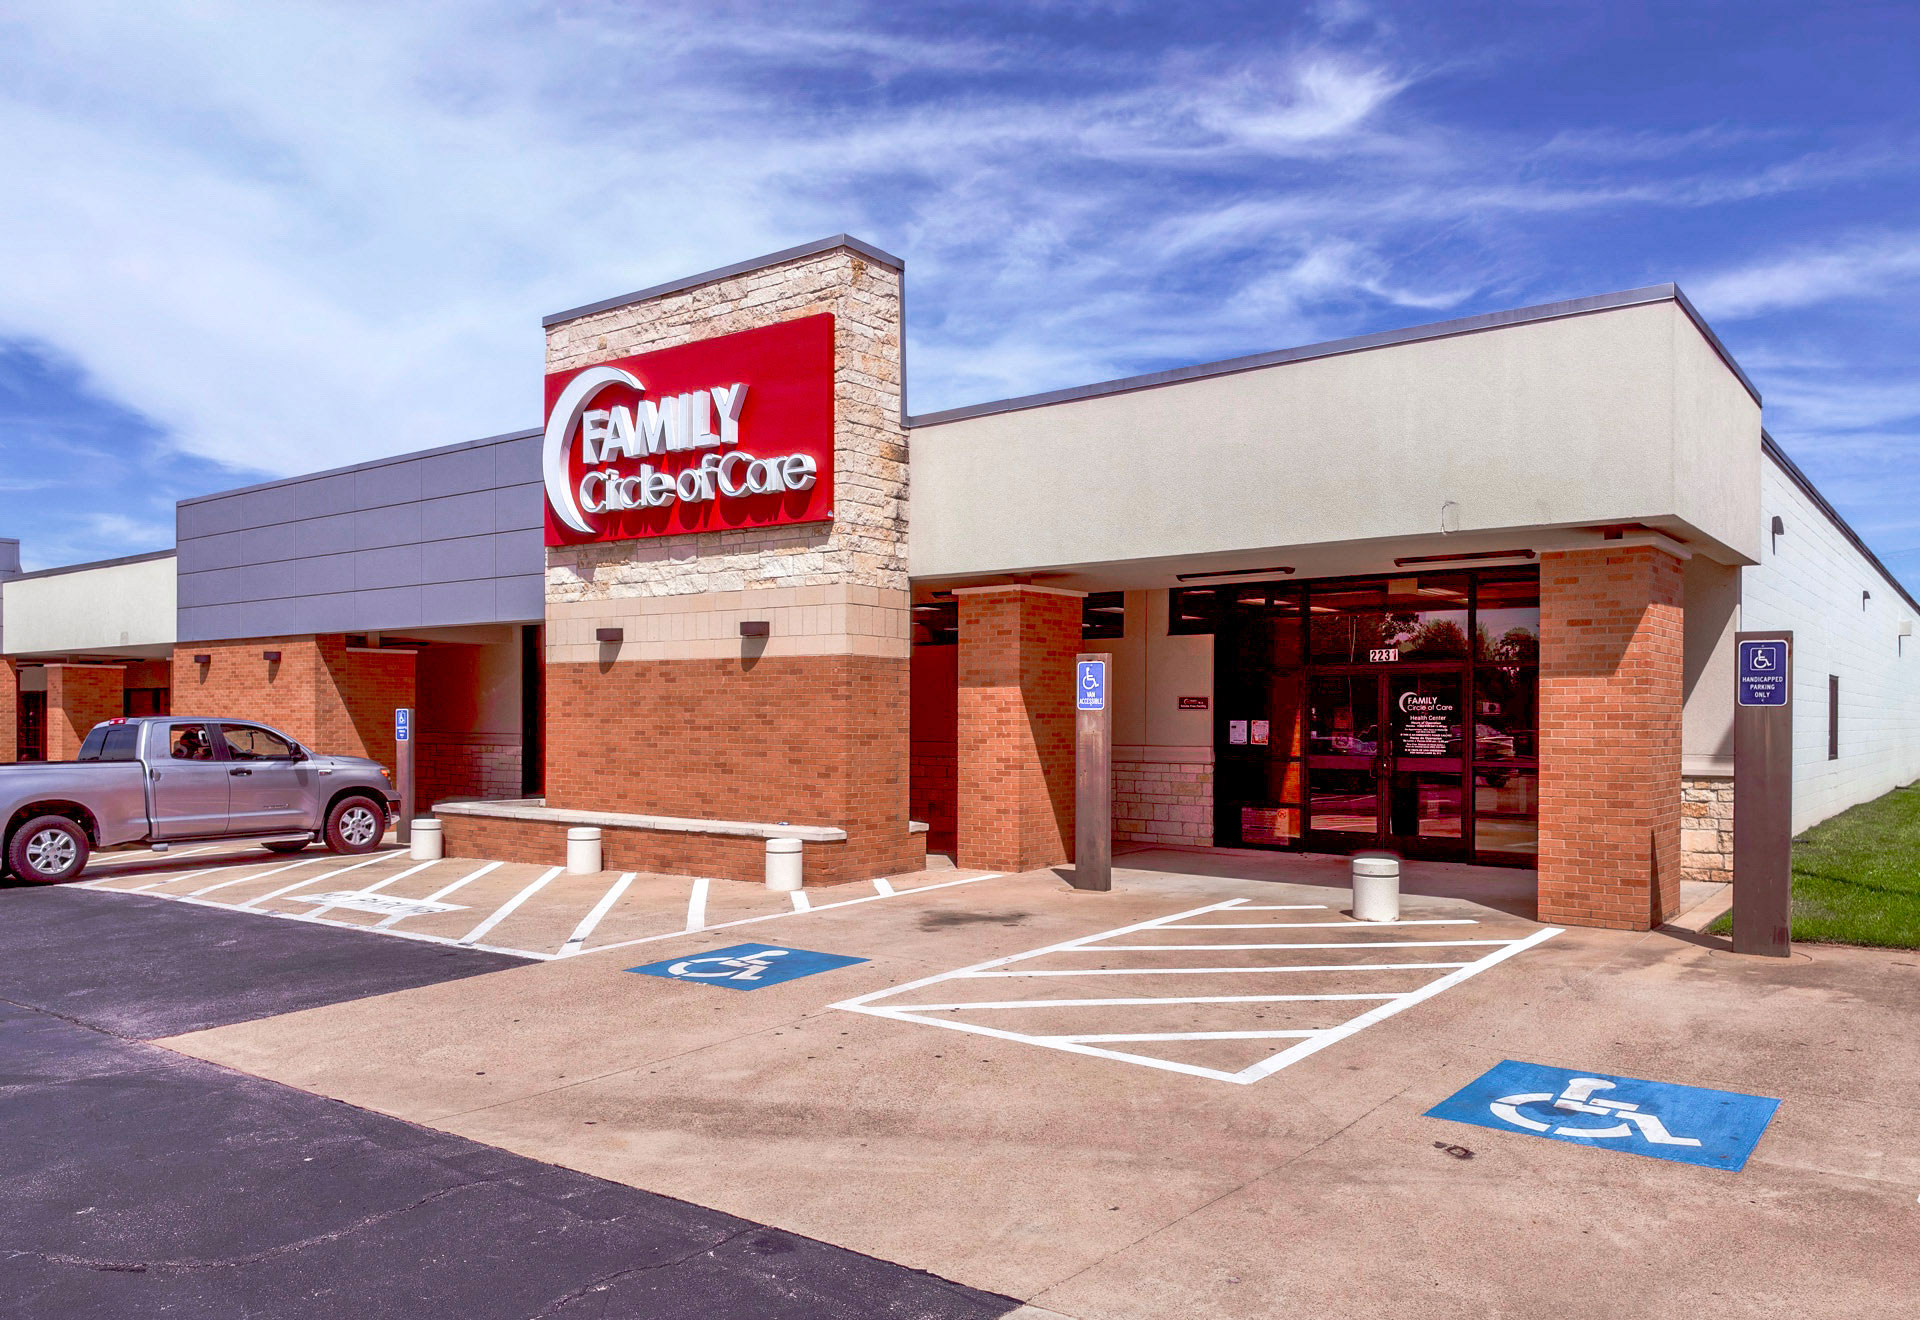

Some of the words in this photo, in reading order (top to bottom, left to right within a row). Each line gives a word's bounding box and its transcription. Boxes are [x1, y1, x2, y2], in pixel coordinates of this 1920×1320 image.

[582, 383, 749, 465] FAMILY
[579, 463, 676, 514] Circle
[676, 453, 722, 502] of
[717, 450, 817, 498] Care
[1371, 650, 1397, 661] 2231
